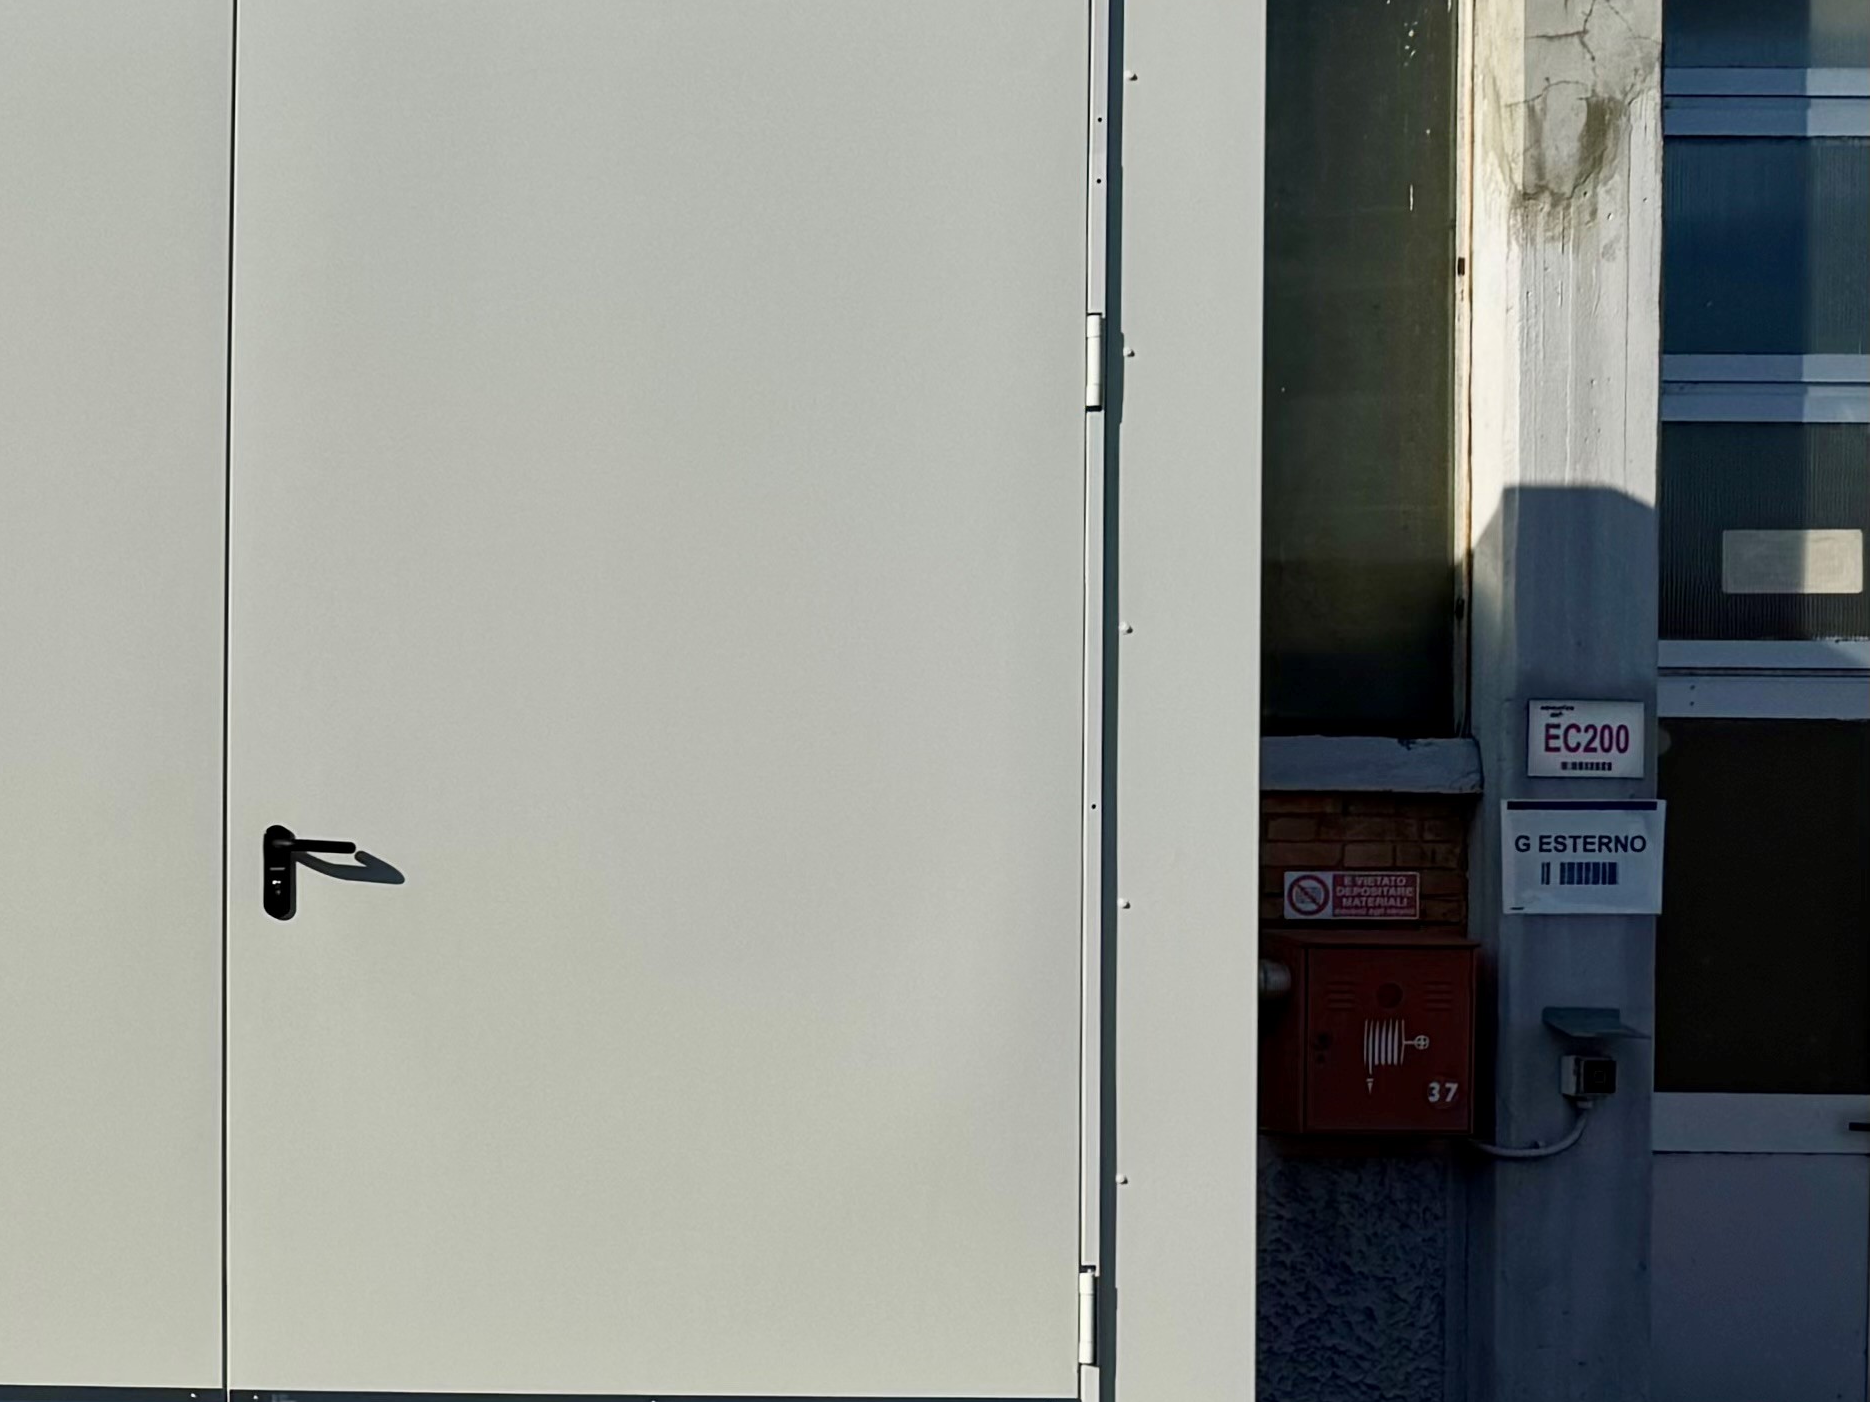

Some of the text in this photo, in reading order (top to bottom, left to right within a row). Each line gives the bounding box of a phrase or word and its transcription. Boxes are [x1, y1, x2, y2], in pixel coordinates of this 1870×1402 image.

[1543, 722, 1631, 754] EC200
[1514, 835, 1647, 853] G ESTERNO
[1355, 876, 1407, 886] VIETATO
[1335, 886, 1415, 897] DEPOSITARE
[1342, 898, 1408, 908] MATERIALI
